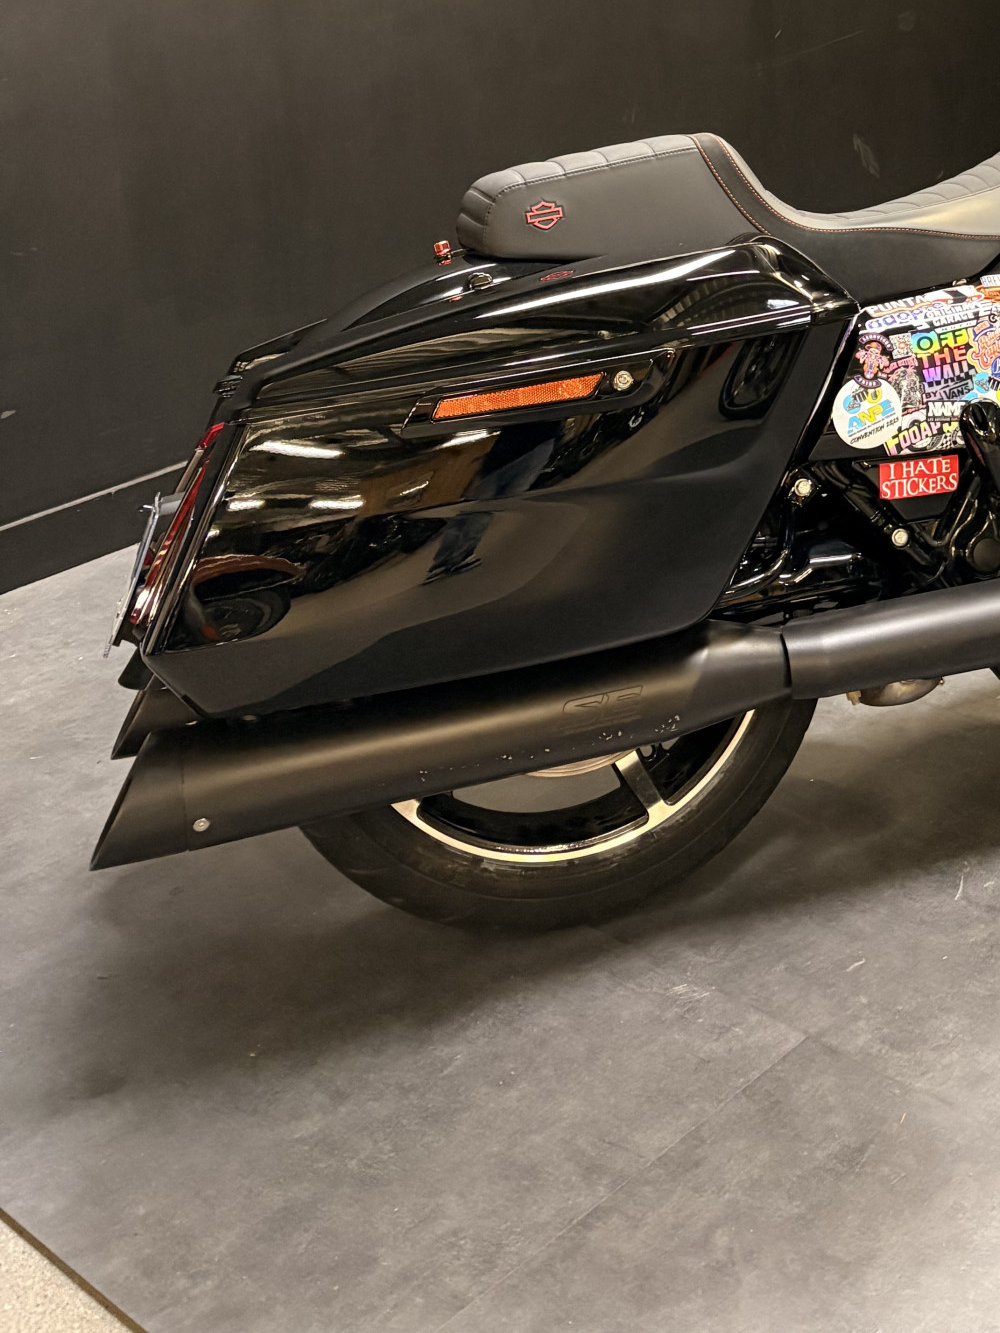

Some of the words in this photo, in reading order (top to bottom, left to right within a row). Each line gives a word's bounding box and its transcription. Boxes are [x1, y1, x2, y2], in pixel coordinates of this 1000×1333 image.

[933, 311, 974, 327] GARAGE
[916, 329, 968, 351] OFF
[917, 345, 967, 369] THE
[923, 360, 975, 383] WALL
[925, 390, 938, 399] BY
[942, 382, 971, 400] VANS
[889, 464, 895, 479] I
[902, 458, 951, 478] HATE
[881, 473, 958, 499] STICKERS
